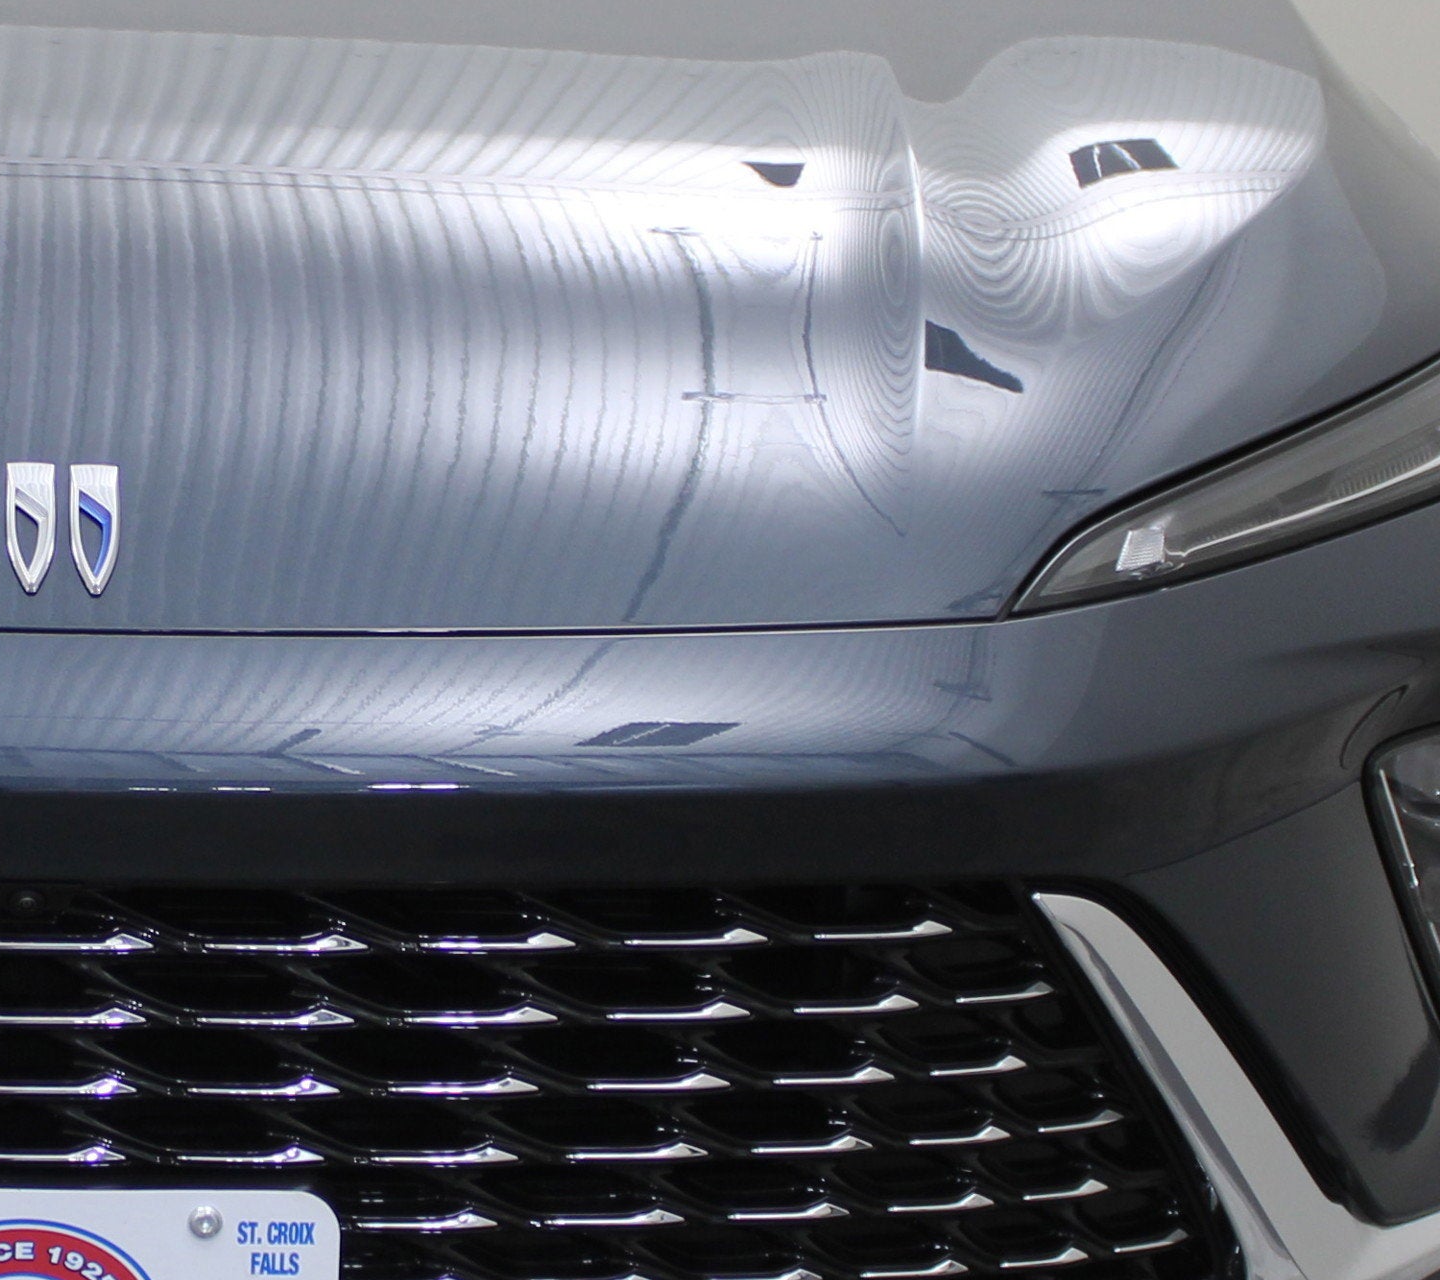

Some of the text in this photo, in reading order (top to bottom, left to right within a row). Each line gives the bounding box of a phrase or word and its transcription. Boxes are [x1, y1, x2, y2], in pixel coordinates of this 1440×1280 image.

[237, 1221, 315, 1245] ST. CROIX
[250, 1252, 300, 1275] FALLS
